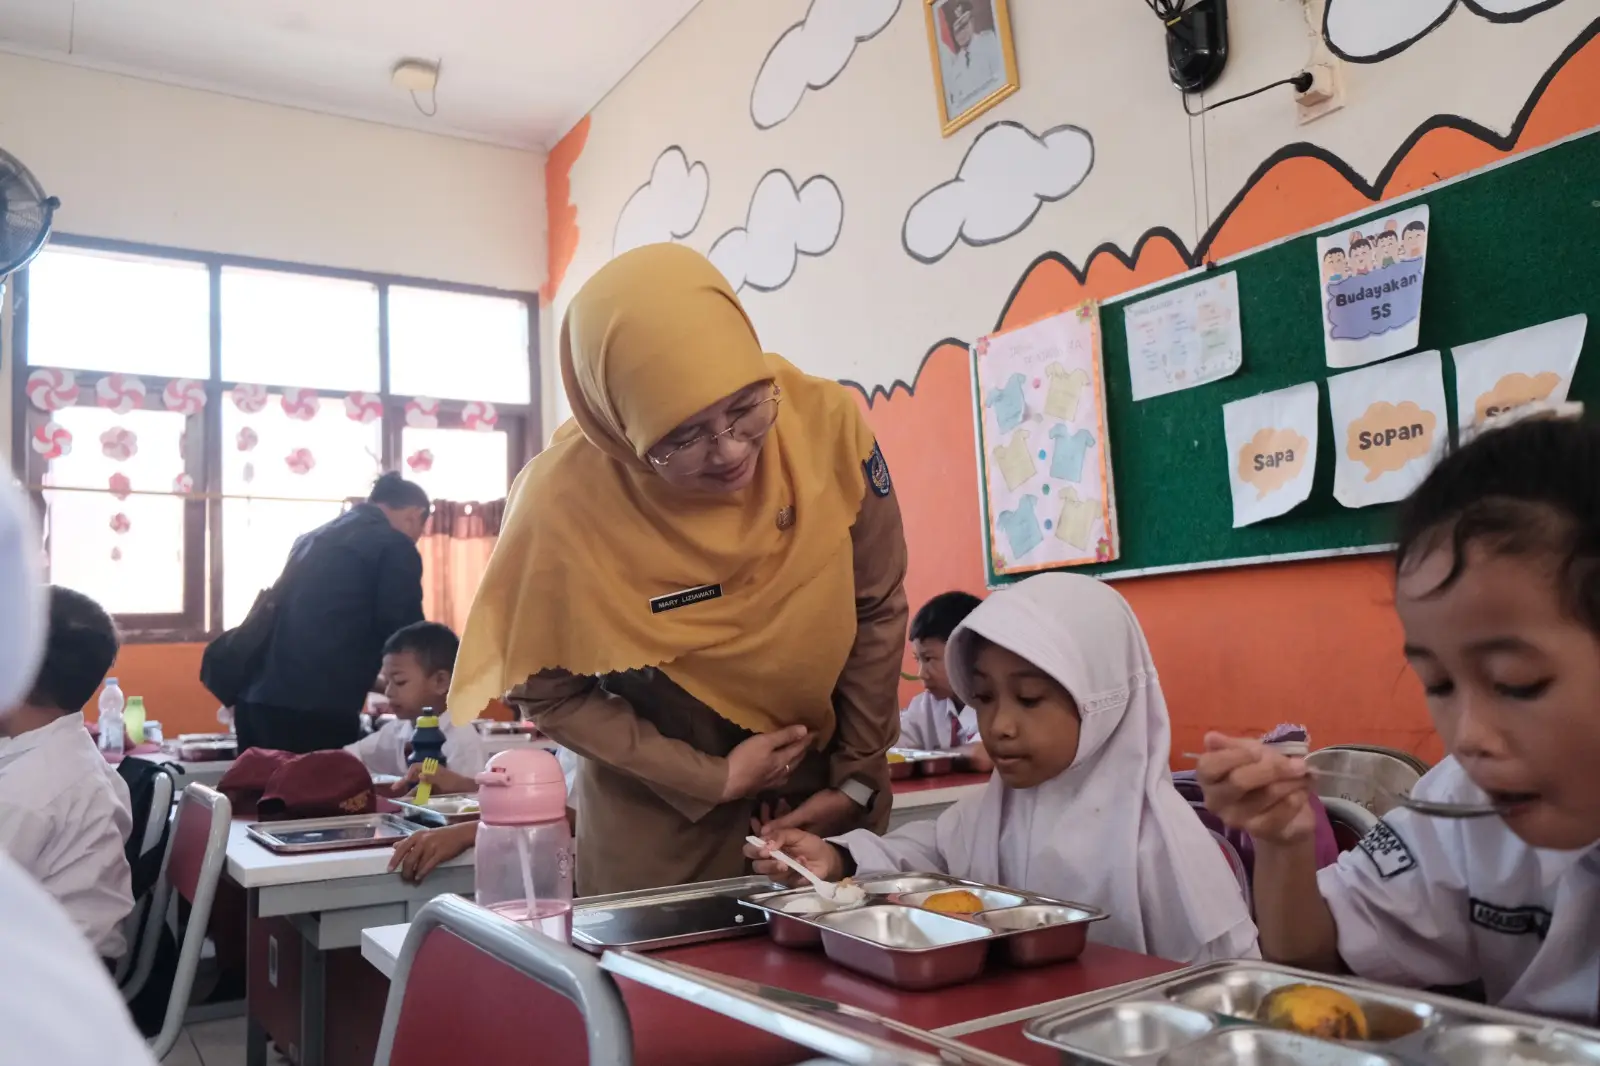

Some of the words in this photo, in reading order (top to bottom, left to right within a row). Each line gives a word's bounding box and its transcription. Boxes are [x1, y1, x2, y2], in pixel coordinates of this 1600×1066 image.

[1336, 274, 1417, 306] Budayakan
[1371, 303, 1392, 321] 5S
[1359, 422, 1423, 450] Sopan
[1253, 448, 1294, 471] Sapa
[658, 599, 678, 608] MARY
[682, 590, 715, 602] LIZIAWATI
[1368, 831, 1391, 855] APOS
